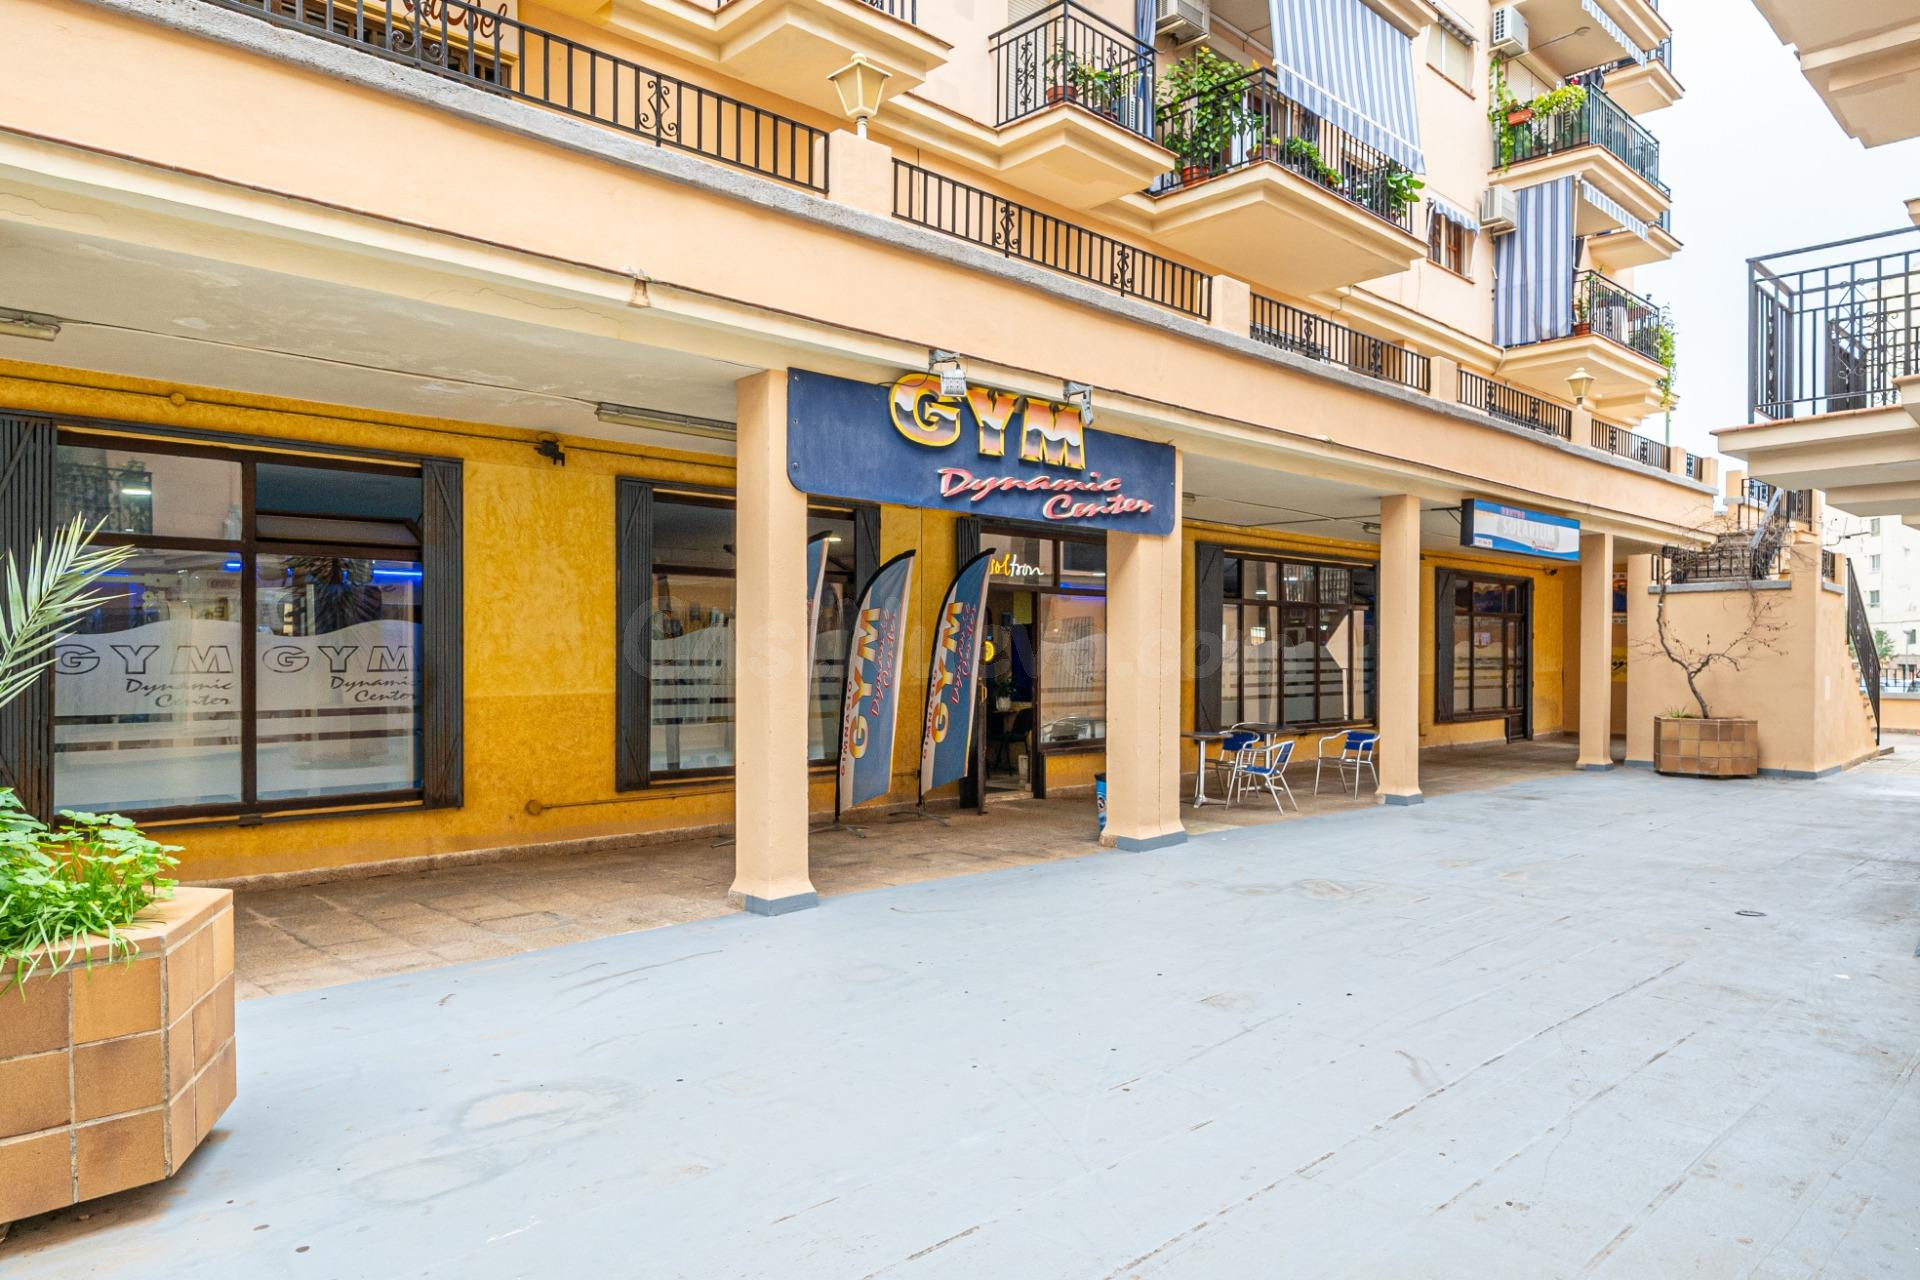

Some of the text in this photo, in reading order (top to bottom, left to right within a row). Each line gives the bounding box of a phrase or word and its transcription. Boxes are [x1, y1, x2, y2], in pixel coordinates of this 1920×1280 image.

[889, 373, 1086, 470] GYM
[937, 467, 1123, 502] Dynamic
[1042, 494, 1154, 520] Center
[55, 643, 234, 675] GYM
[262, 645, 420, 674] GYM
[931, 602, 964, 744] GYM
[126, 678, 233, 697] Dynamic
[850, 607, 881, 759] GYM
[155, 693, 231, 708] Center
